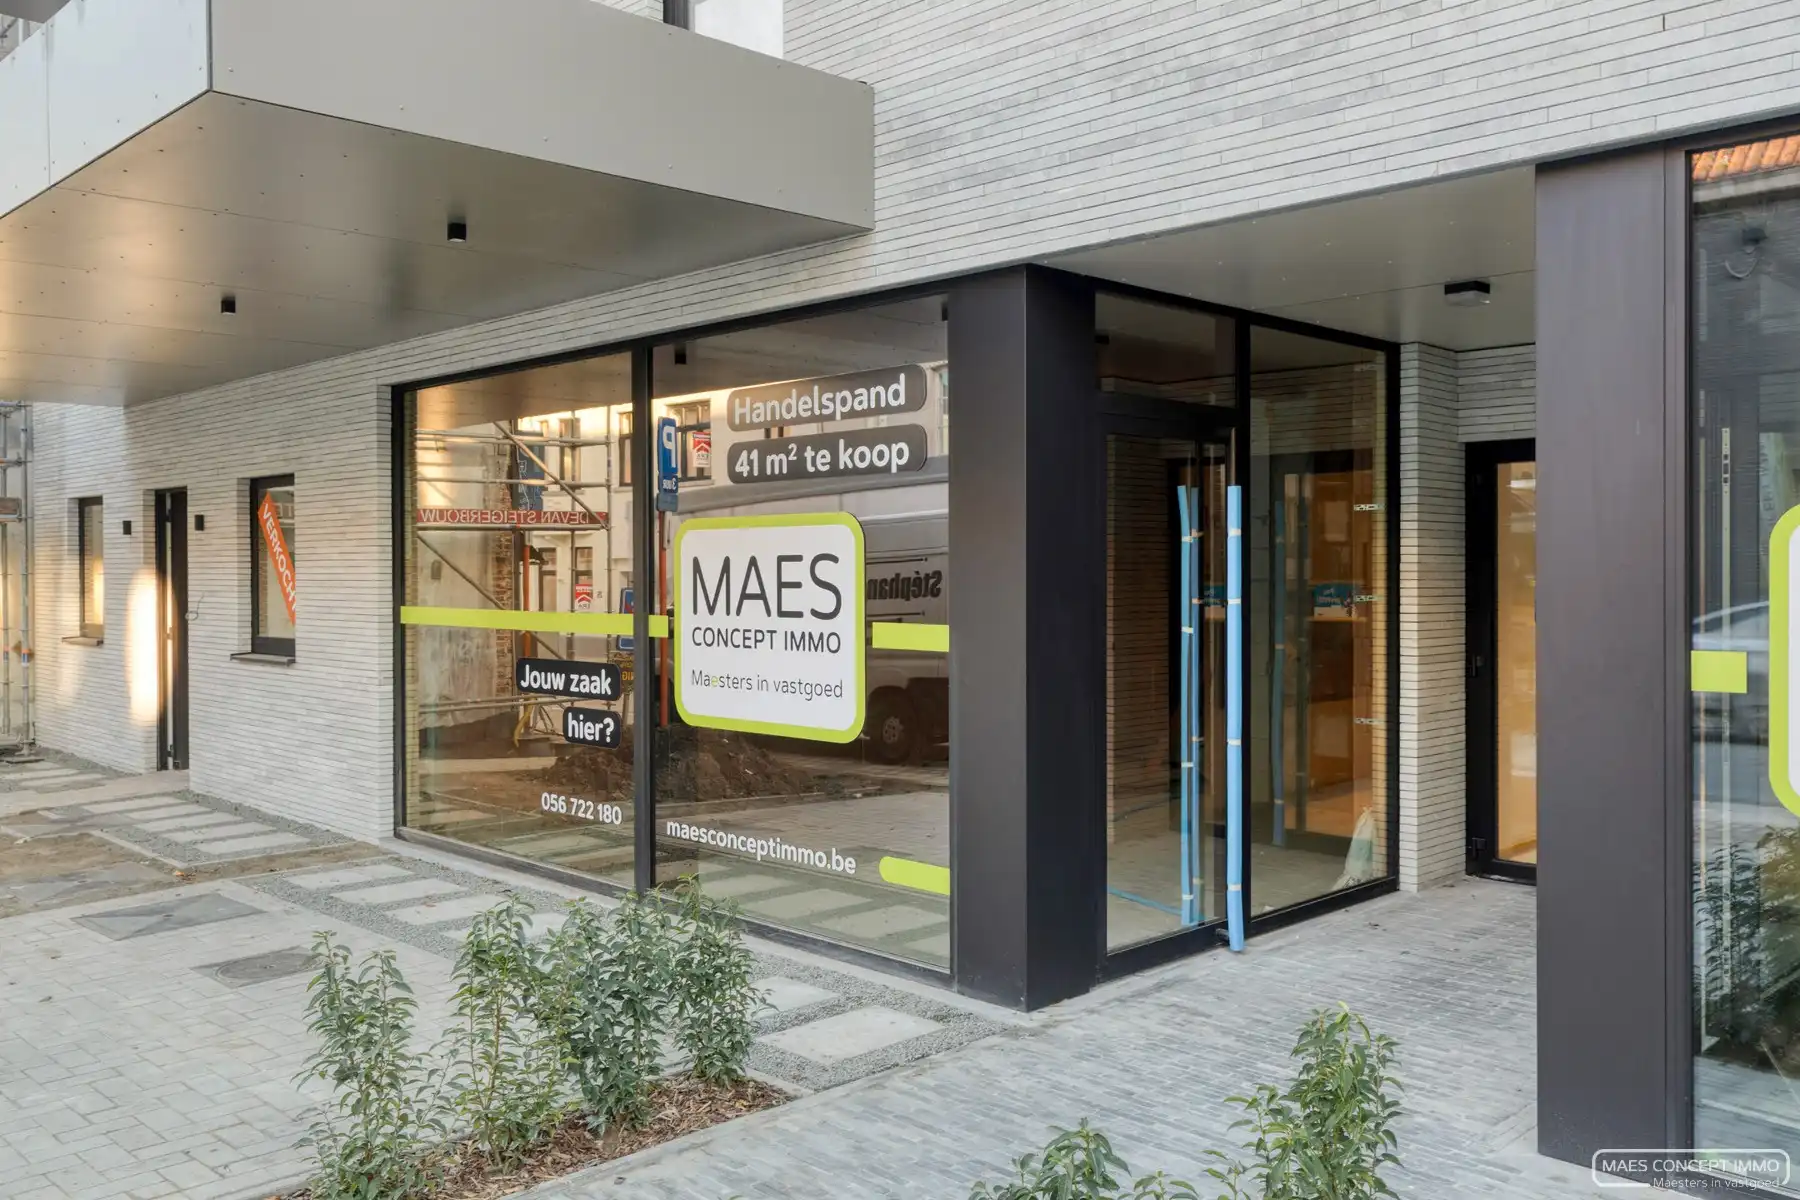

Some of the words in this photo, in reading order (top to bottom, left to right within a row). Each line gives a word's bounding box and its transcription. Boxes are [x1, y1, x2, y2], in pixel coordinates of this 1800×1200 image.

[735, 373, 906, 421] Handelspand
[735, 449, 759, 477] 41
[804, 446, 831, 473] te
[838, 438, 910, 474] koop
[692, 553, 842, 621] MAES
[692, 626, 777, 650] CONCEPT
[784, 631, 841, 654] IMMO
[520, 664, 565, 691] Jouw
[569, 669, 612, 695] zaak
[691, 669, 753, 691] Maesters
[757, 674, 769, 692] in
[773, 679, 843, 701] vastgoed
[567, 712, 615, 743] hier?
[541, 792, 567, 813] 056
[569, 797, 594, 821] 722
[597, 803, 622, 826] 180
[666, 819, 857, 874] maesconceptimmo.be
